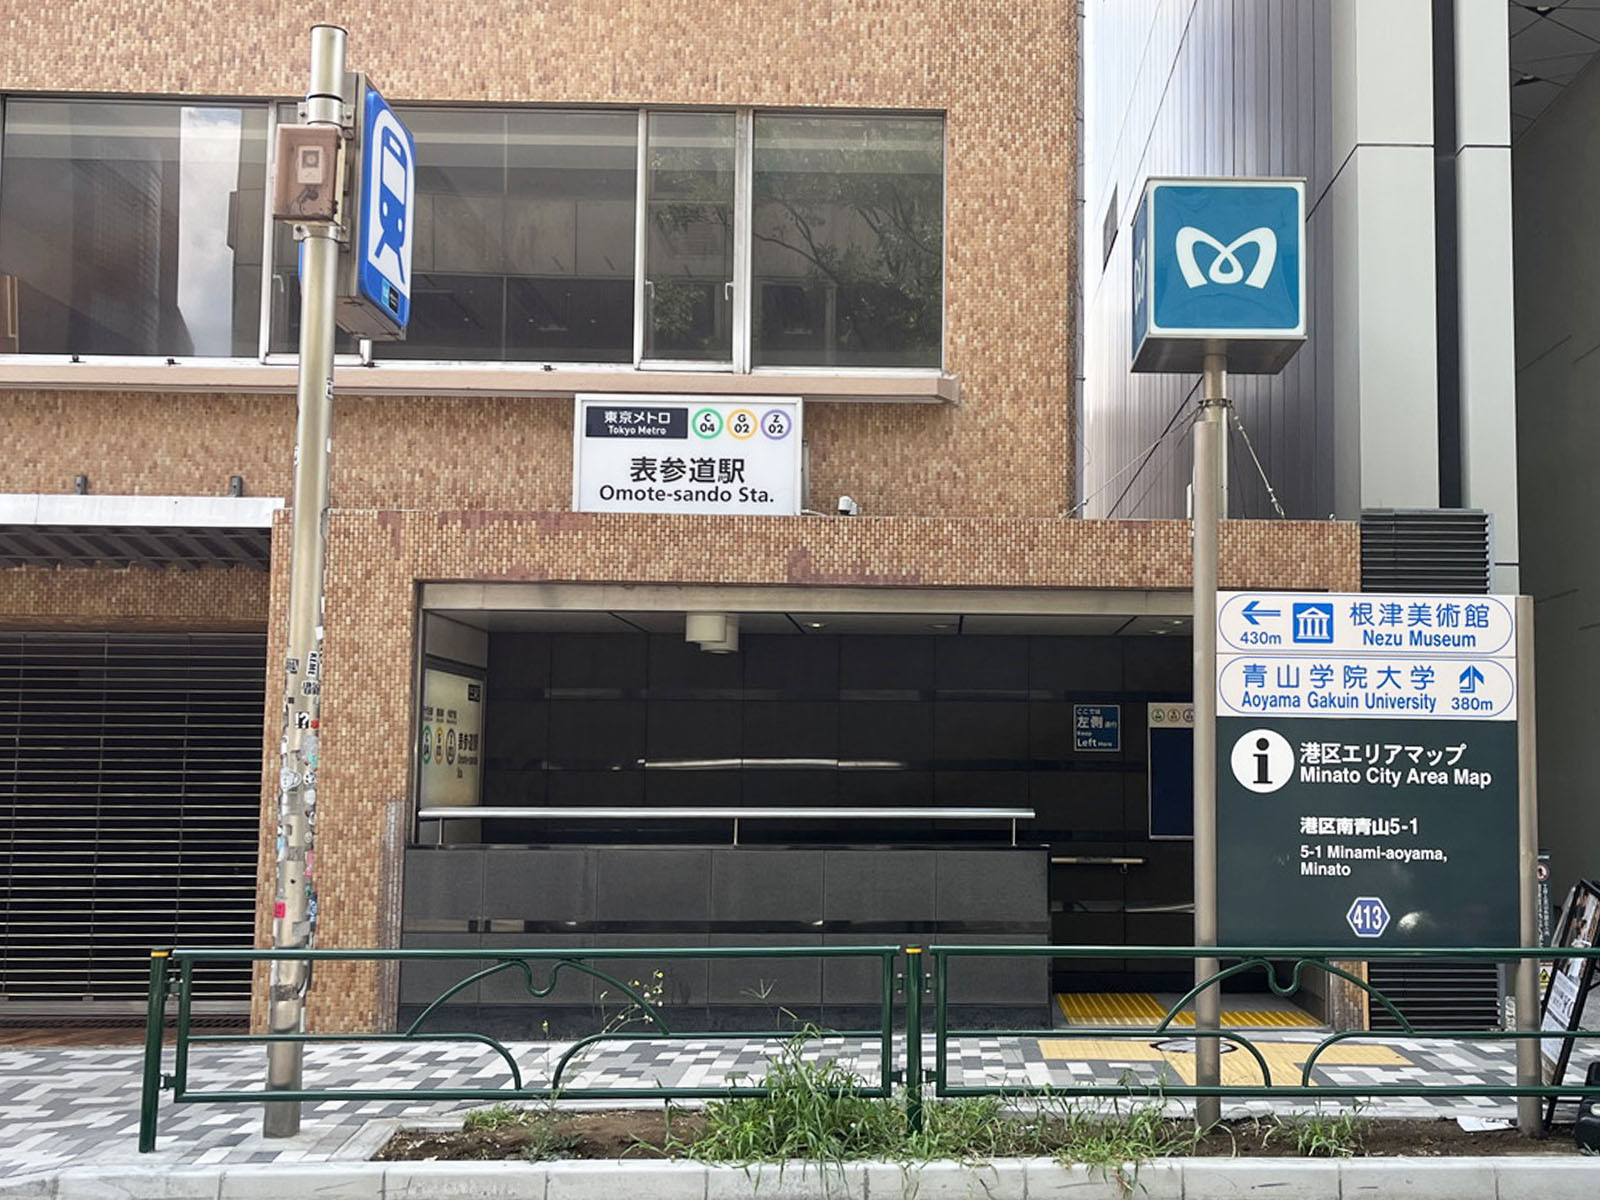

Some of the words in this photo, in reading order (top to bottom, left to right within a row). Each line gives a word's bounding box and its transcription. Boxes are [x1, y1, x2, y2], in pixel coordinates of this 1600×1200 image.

[604, 410, 671, 424] 東京メトロ
[704, 414, 711, 422] C
[737, 414, 746, 423] G
[773, 415, 780, 423] Z
[608, 425, 636, 436] Tokyo
[638, 426, 667, 435] Metro
[699, 423, 715, 433] 04
[734, 424, 750, 434] 02
[768, 424, 784, 434] 02
[630, 456, 745, 484] 表参道駅
[600, 484, 732, 502] Omote-sando
[738, 486, 774, 503] Sta.
[1349, 602, 1490, 628] 根津美術館
[1240, 631, 1281, 645] 430m
[1362, 630, 1403, 647] Nezu
[1409, 630, 1476, 647] Museum
[1242, 663, 1436, 691] 青山学院大学
[1241, 691, 1301, 711] Aoyama
[1307, 692, 1359, 709] Gakuin
[1365, 692, 1436, 713] University
[1451, 697, 1493, 711] 380m
[1077, 738, 1097, 747] Left
[1300, 742, 1467, 766] 港区エリアマップ
[1300, 768, 1360, 784] Minato
[1365, 767, 1401, 788] City
[1406, 768, 1449, 785] Area
[1453, 769, 1492, 789] Map
[1300, 817, 1418, 836] 港区南青山5-1
[1300, 845, 1322, 859] 5-1
[1327, 845, 1448, 863] Minami-aoyama,
[1300, 862, 1351, 877] Minato
[1353, 905, 1382, 930] 413
